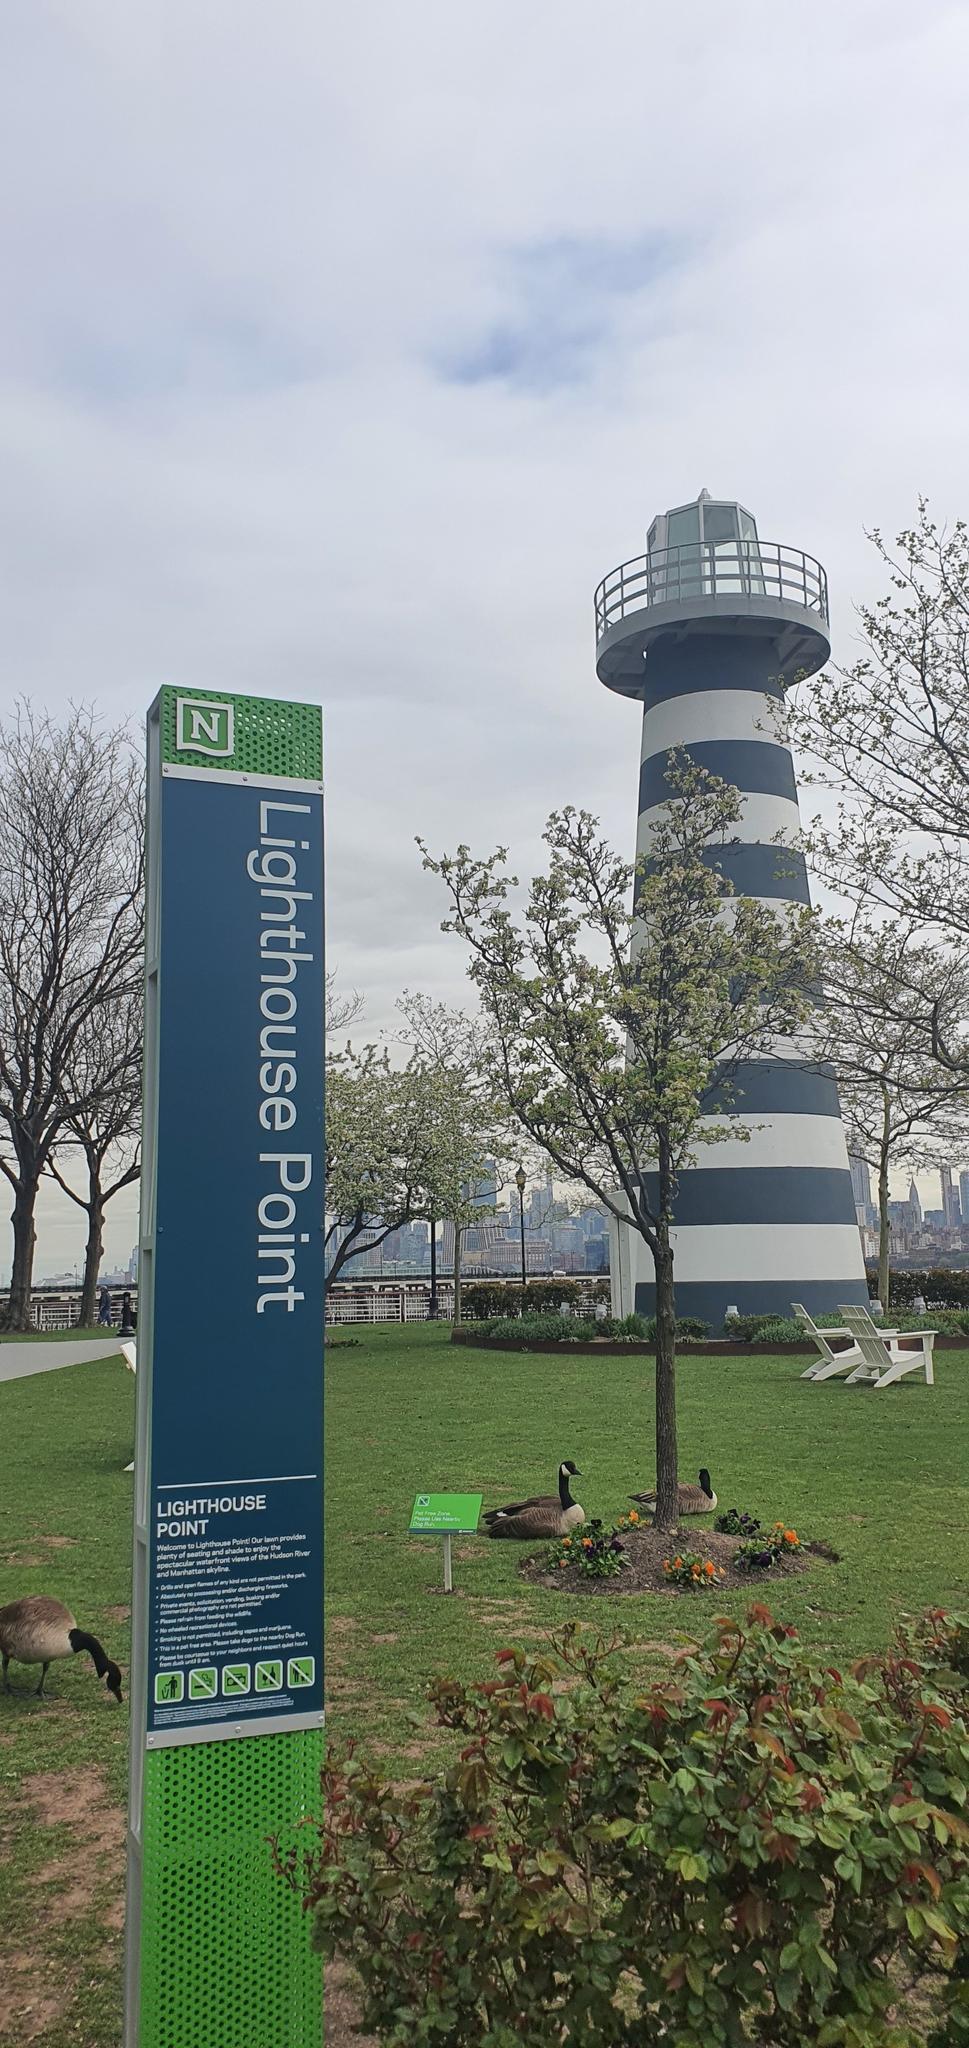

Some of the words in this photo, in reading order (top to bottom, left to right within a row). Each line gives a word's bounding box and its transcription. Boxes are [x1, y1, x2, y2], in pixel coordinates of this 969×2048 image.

[190, 710, 220, 742] N
[246, 800, 314, 1132] Lighthouse
[256, 1153, 312, 1314] Point
[157, 1494, 267, 1517] LIGHTHOUSE
[157, 1520, 209, 1538] POINT
[157, 1544, 186, 1552] Welcome
[195, 1540, 231, 1550] Lighthouse
[232, 1537, 250, 1546] Point!
[280, 1533, 306, 1543] provides
[156, 1553, 177, 1562] plenty
[186, 1550, 210, 1558] seating
[212, 1548, 224, 1556] and
[225, 1547, 244, 1555] shade
[253, 1545, 270, 1553] enjoy
[156, 1560, 195, 1570] spectacular
[196, 1556, 230, 1566] waterfront
[156, 1570, 169, 1578] and
[170, 1568, 206, 1577] Manhattan
[206, 1566, 230, 1574] skyline.
[257, 1574, 281, 1582] permitted
[160, 1592, 187, 1600] Absolutely
[189, 1605, 219, 1614] photography
[168, 1625, 188, 1633] wheeled
[189, 1622, 218, 1631] recreational
[160, 1635, 181, 1643] Smoking
[262, 1643, 281, 1651] respect
